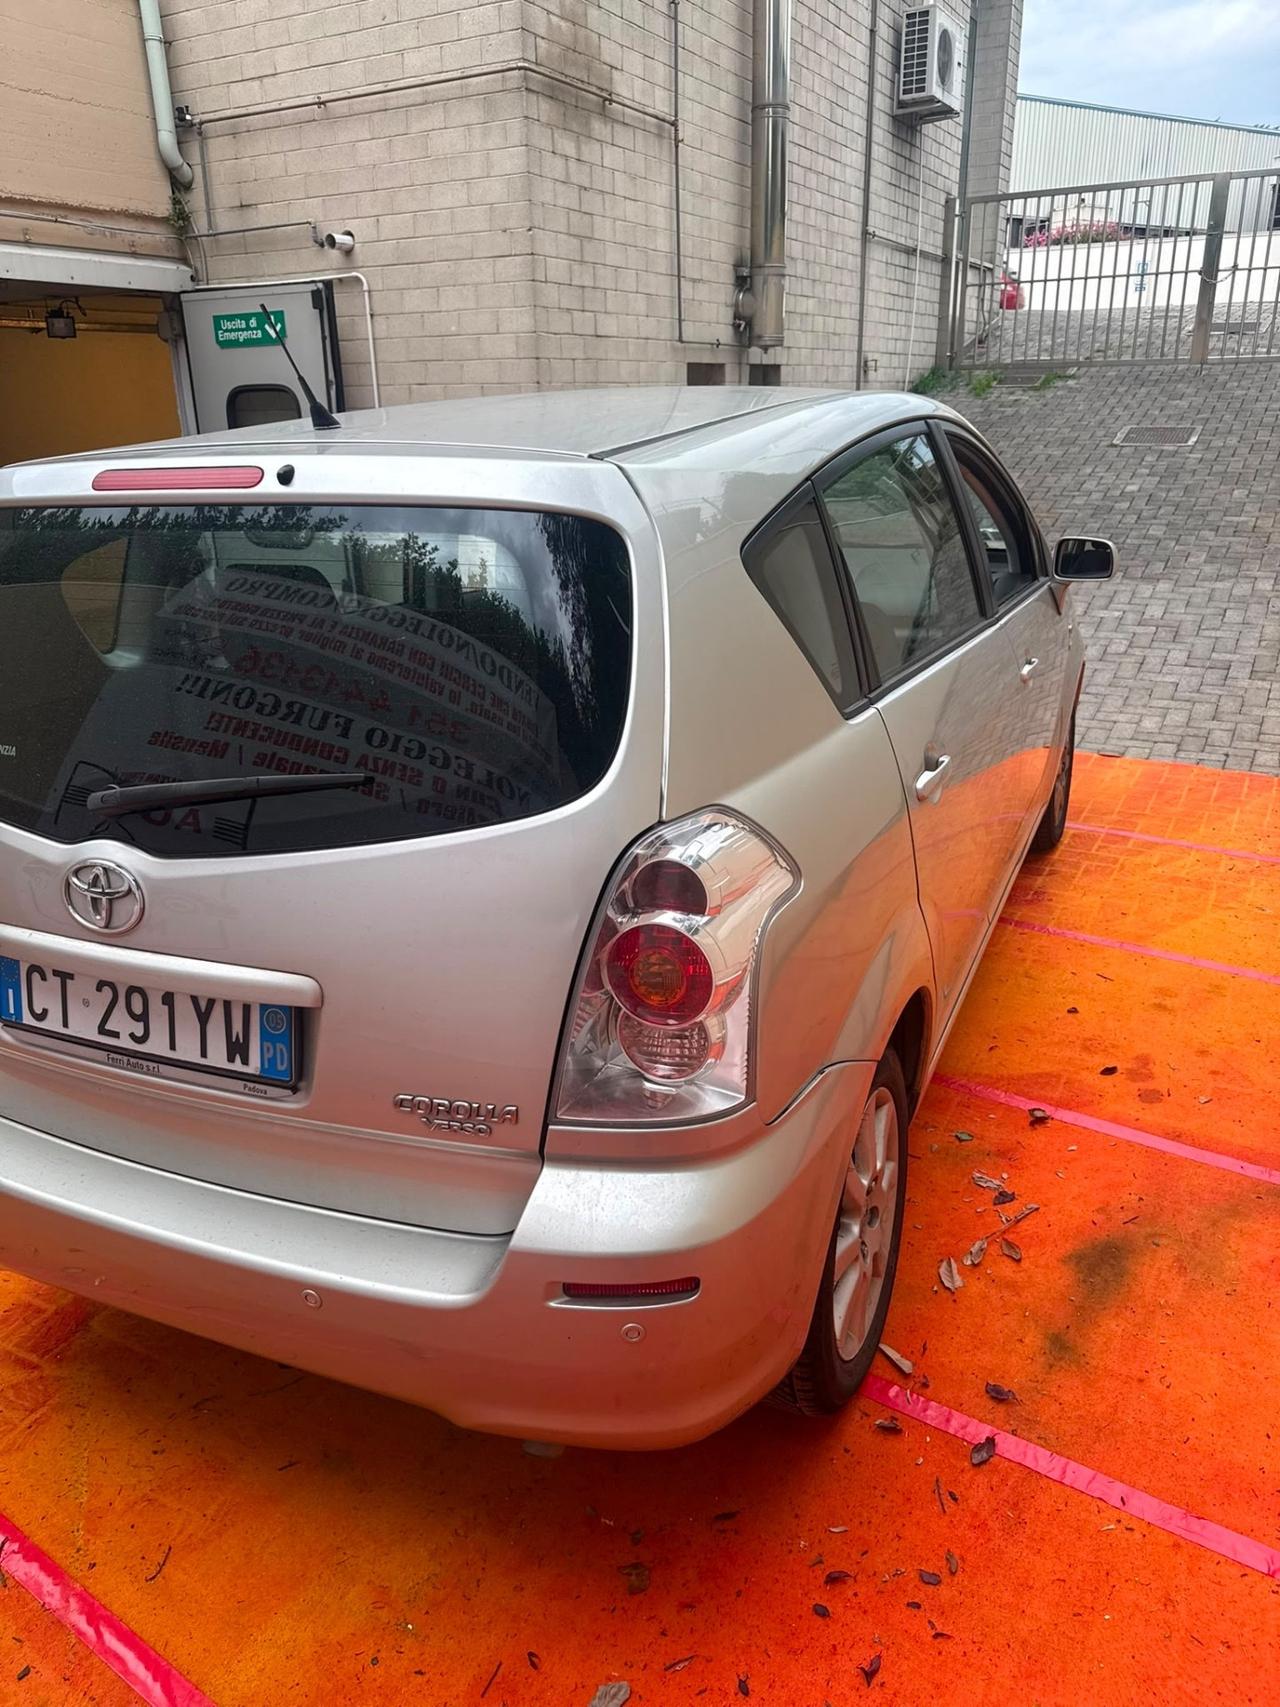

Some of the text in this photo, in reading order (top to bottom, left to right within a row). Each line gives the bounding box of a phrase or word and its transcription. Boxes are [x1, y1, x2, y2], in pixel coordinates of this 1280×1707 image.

[220, 317, 257, 330] Uscita di
[218, 329, 262, 342] Emergenza
[26, 963, 75, 1029] CT
[96, 980, 251, 1066] 291YW
[107, 1053, 124, 1066] Ferri
[126, 1058, 144, 1071] Auto
[263, 1041, 288, 1072] PD
[243, 1083, 268, 1096] Padova
[393, 1093, 519, 1126] COROLLA
[420, 1117, 492, 1137] VERSO
